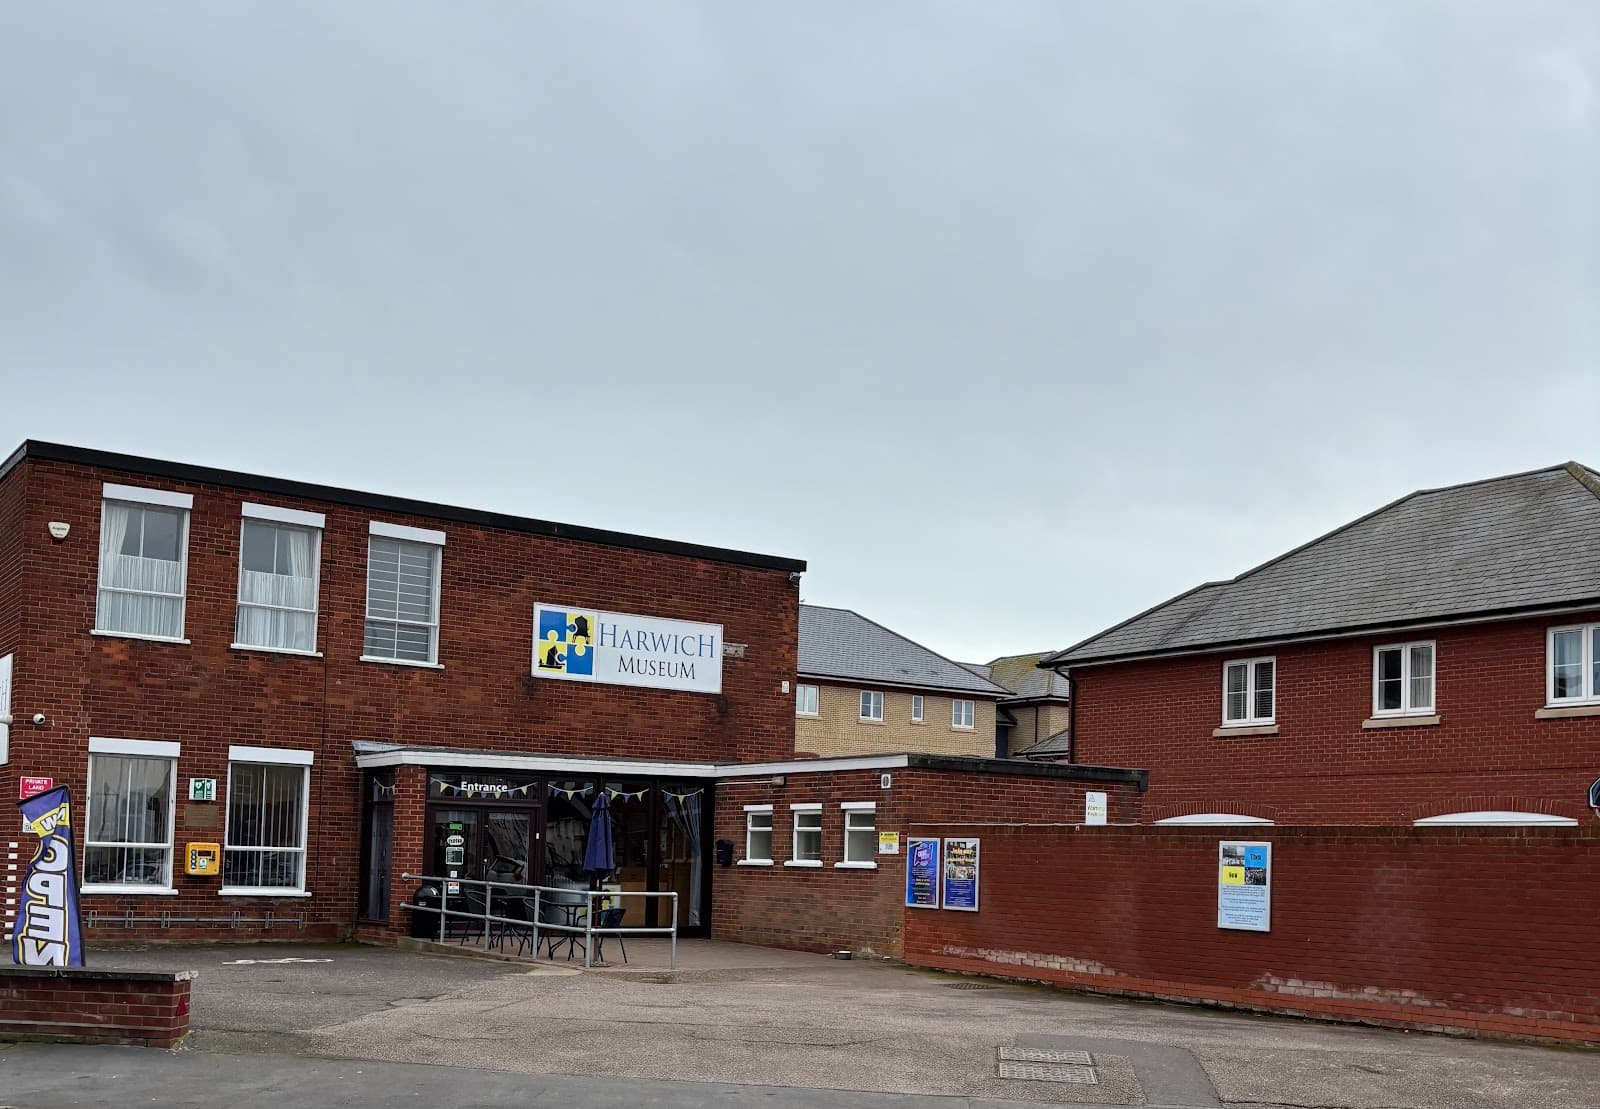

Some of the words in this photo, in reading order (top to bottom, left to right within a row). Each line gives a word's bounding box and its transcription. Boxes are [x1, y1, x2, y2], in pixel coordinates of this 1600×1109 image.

[600, 623, 714, 658] HARWICH
[618, 656, 695, 679] MUSEUM
[461, 781, 508, 792] Entrance
